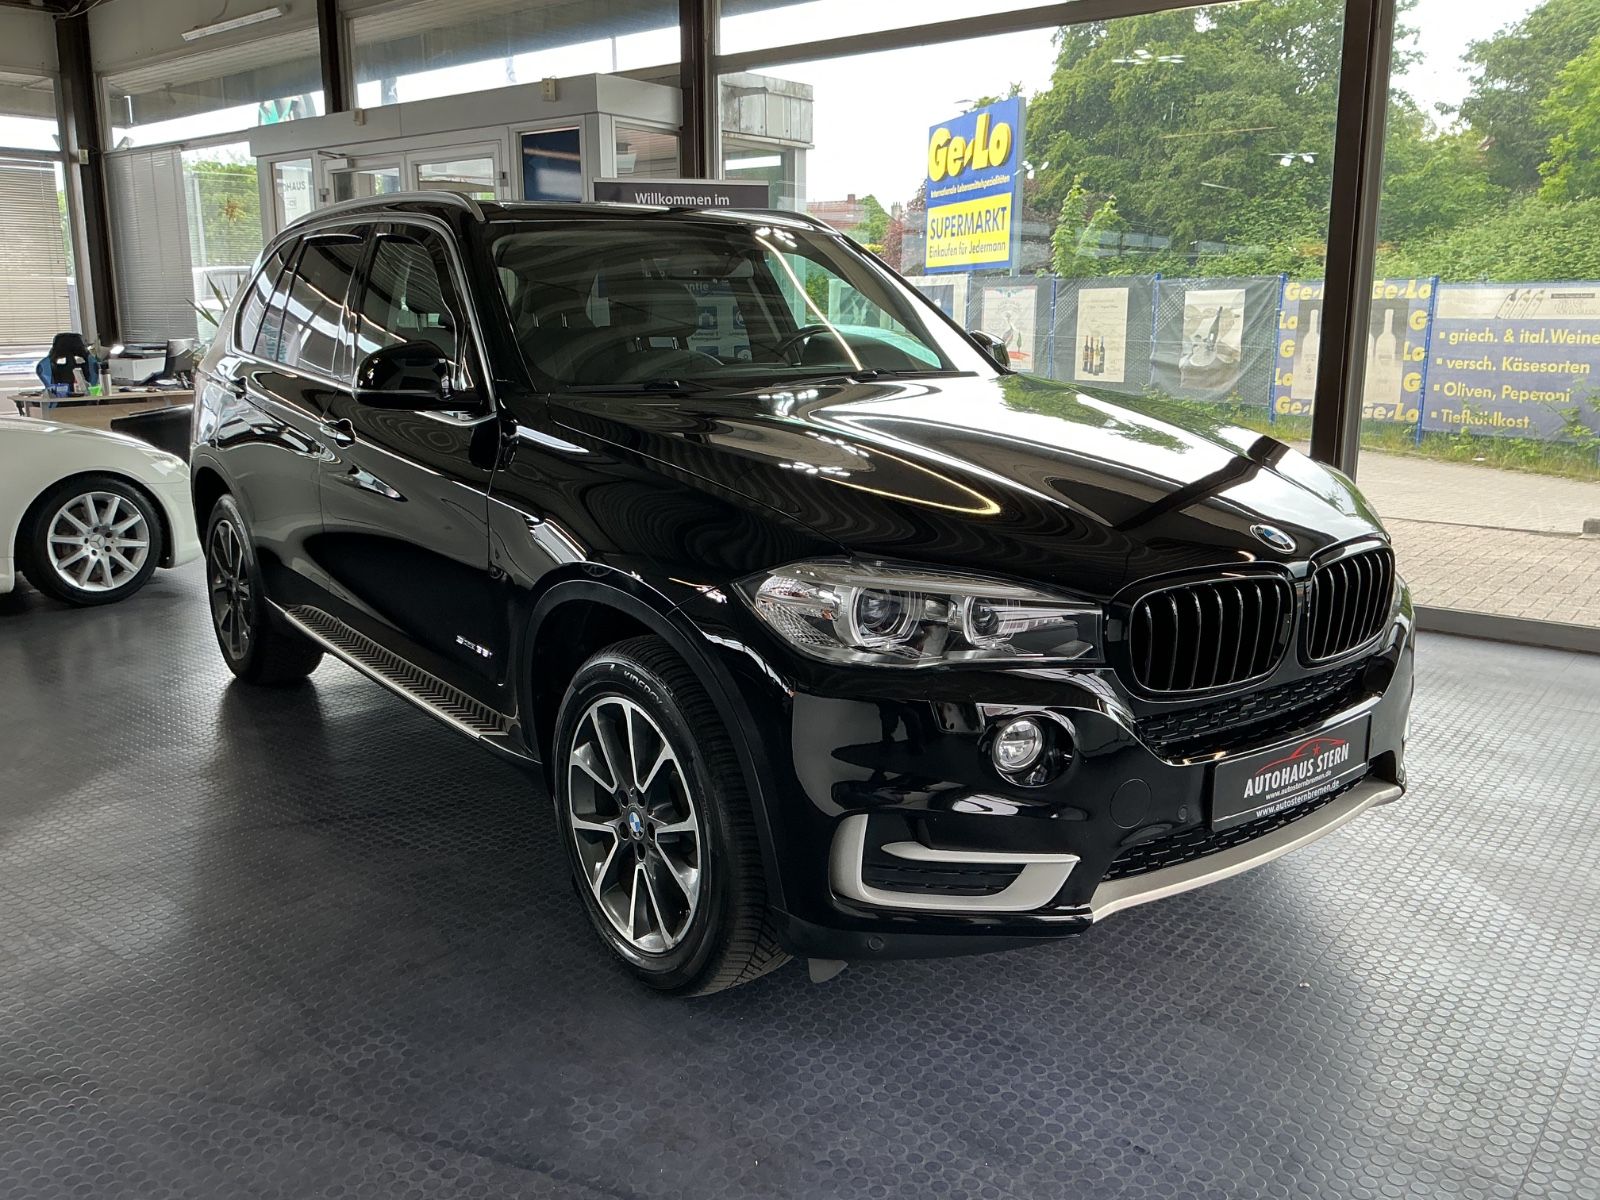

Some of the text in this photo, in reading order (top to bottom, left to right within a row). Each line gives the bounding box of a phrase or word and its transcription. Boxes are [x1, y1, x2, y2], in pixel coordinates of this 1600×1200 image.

[635, 192, 730, 206] Willkommen im
[930, 206, 1007, 240] SUPERMARKT
[929, 240, 1006, 259] Einkaufen für Jedermann
[1449, 327, 1499, 345] griech.
[1503, 328, 1515, 343] &
[1446, 355, 1590, 374] versch. Käsesorten
[1443, 382, 1571, 403] Oliven, Peperoni
[1244, 743, 1350, 799] AUTOHAUS STERN
[1265, 770, 1332, 801] www.autosternbremen.de
[1256, 779, 1340, 818] www.autosternbremen.de
